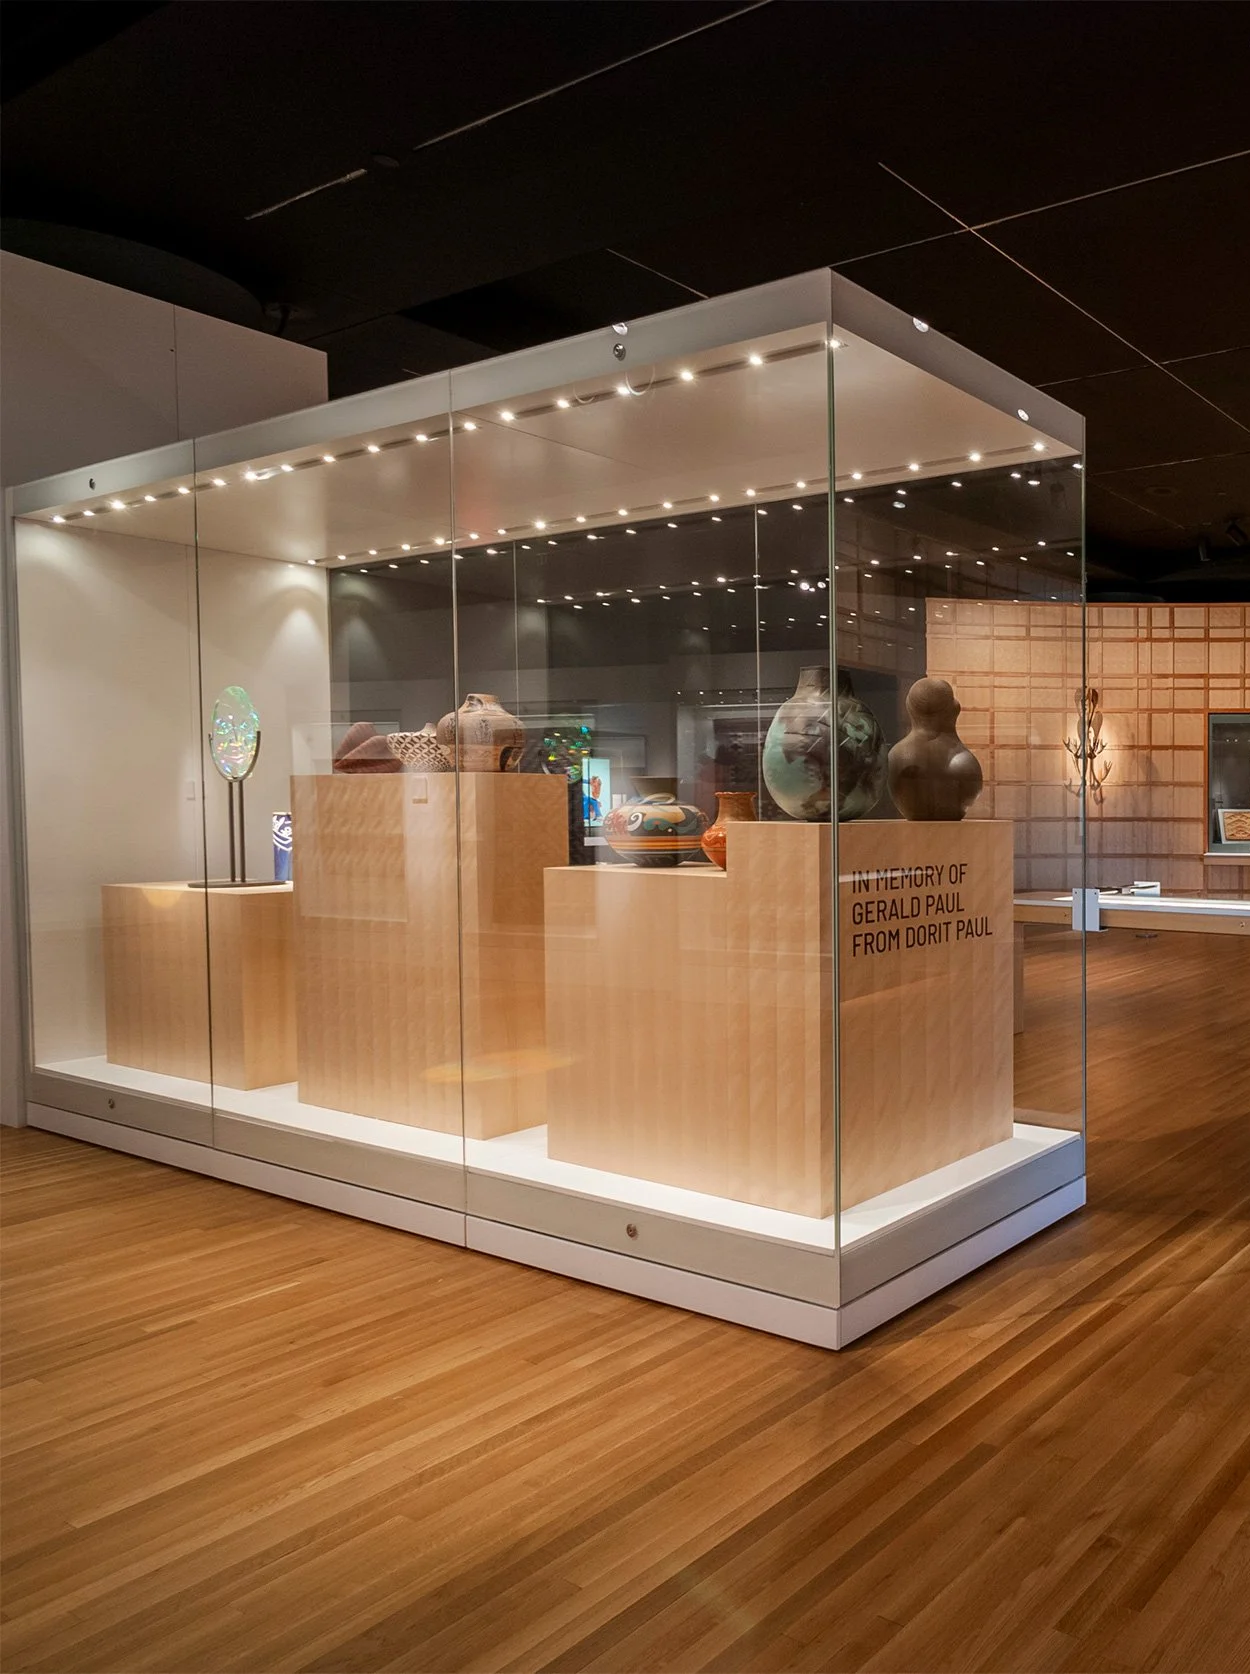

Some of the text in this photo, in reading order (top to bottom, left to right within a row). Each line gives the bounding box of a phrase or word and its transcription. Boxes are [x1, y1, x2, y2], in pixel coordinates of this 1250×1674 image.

[852, 863, 968, 894] IN MEMORY OF
[852, 892, 965, 925] GERALD PAUL
[852, 916, 993, 957] FROM DORIT PAUL
